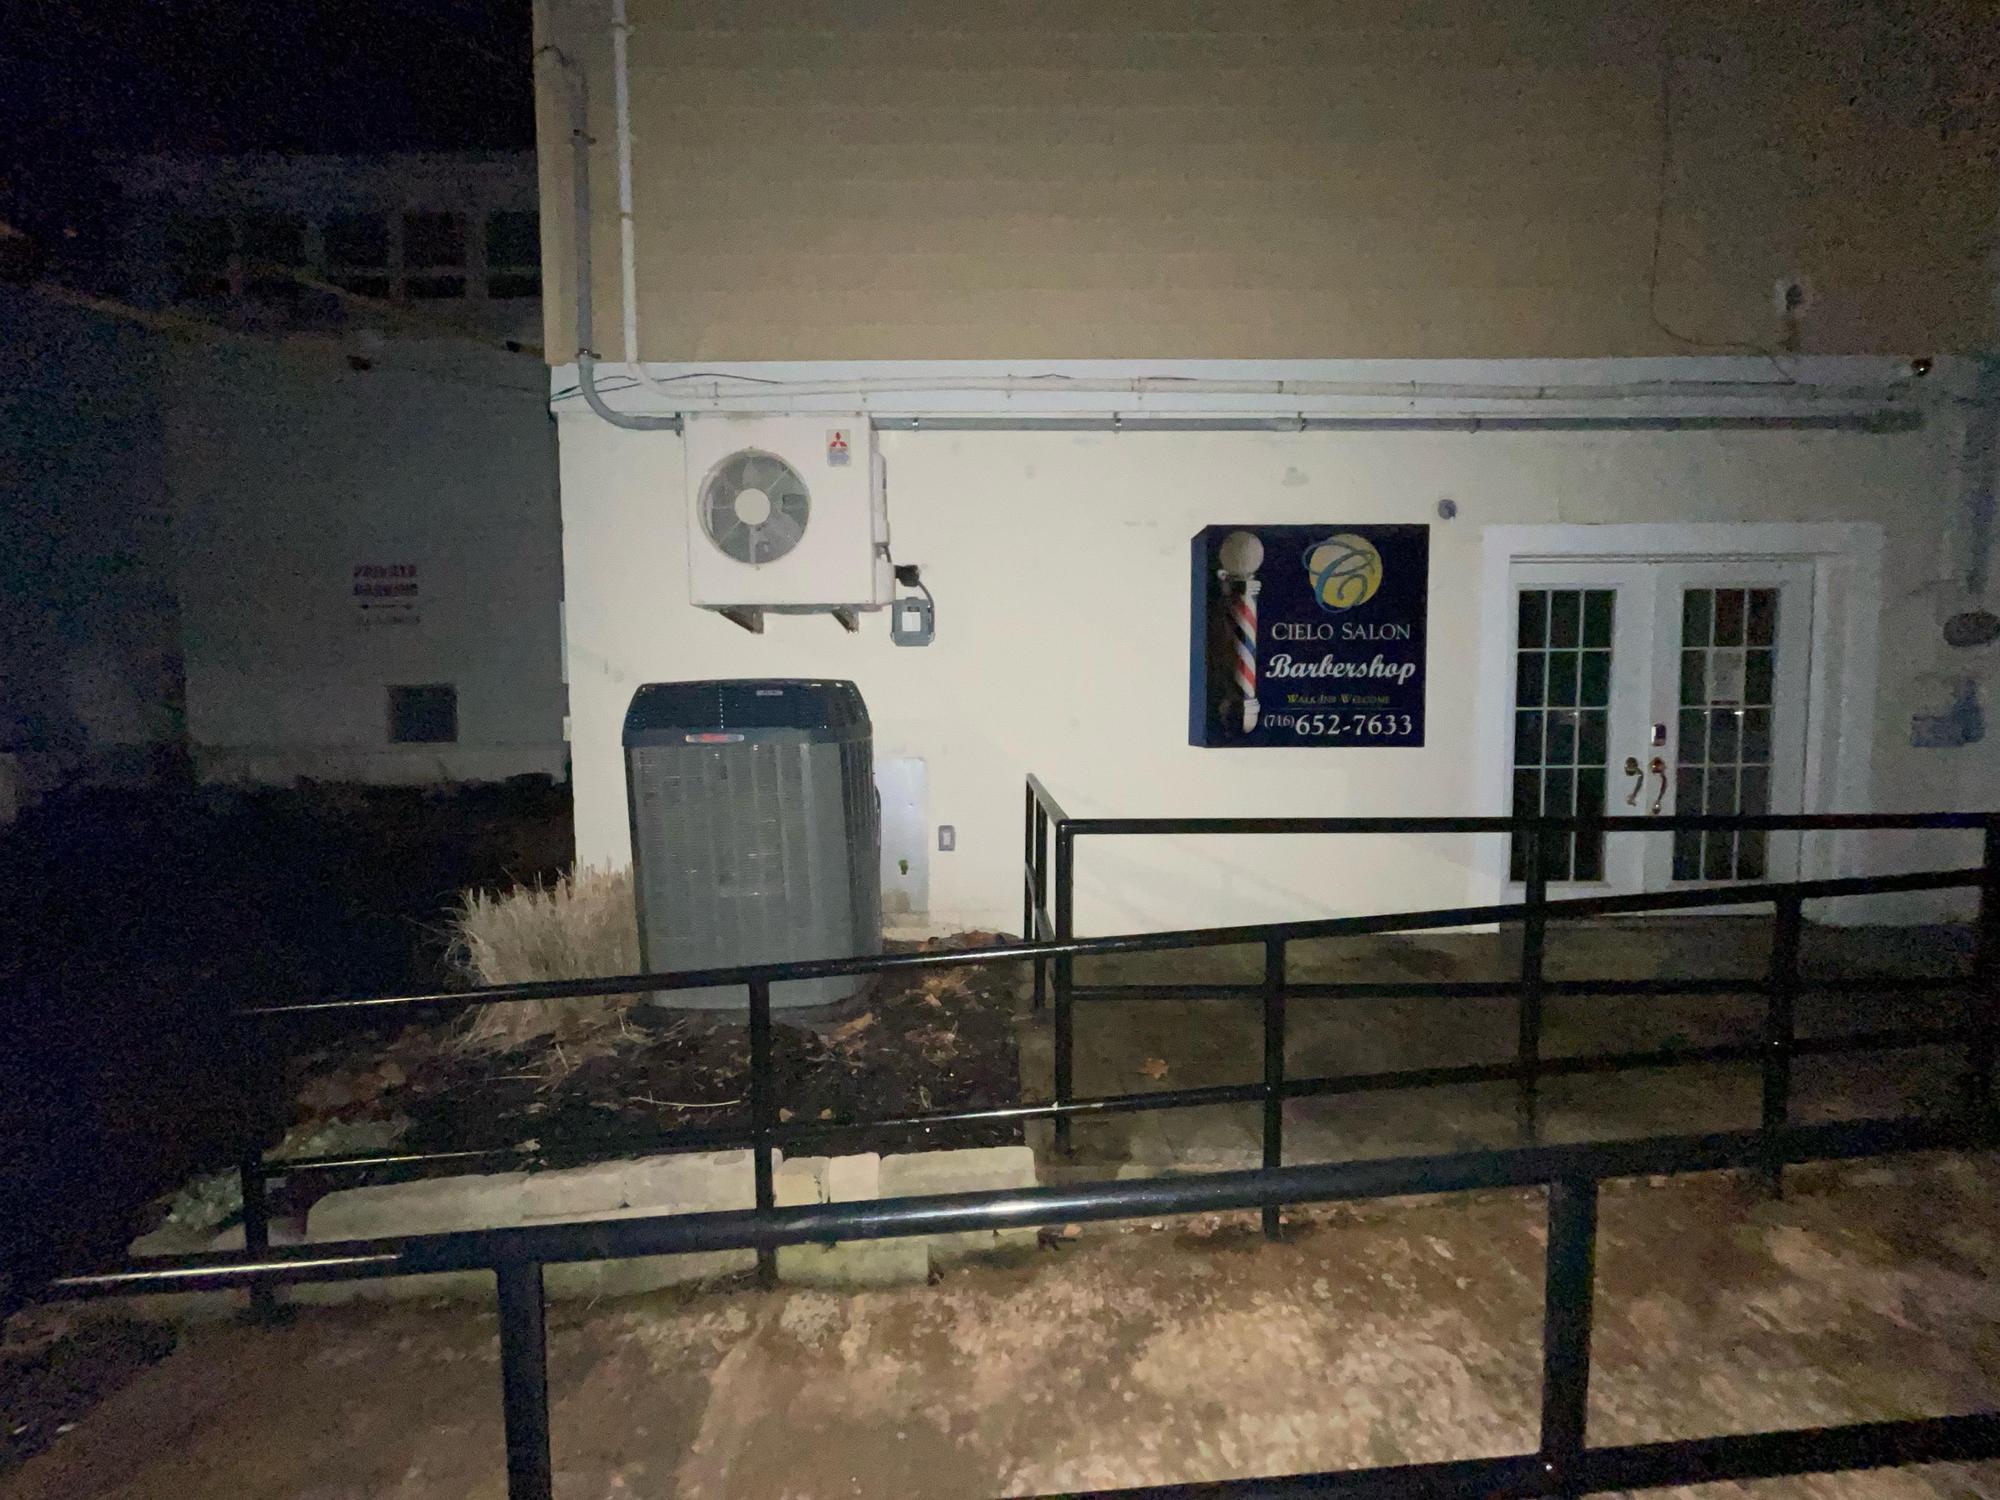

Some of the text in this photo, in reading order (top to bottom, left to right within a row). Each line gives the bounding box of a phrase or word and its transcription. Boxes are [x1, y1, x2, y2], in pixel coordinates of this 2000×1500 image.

[1271, 622, 1411, 641] CIELO SALON
[1265, 653, 1416, 685] Barbershop
